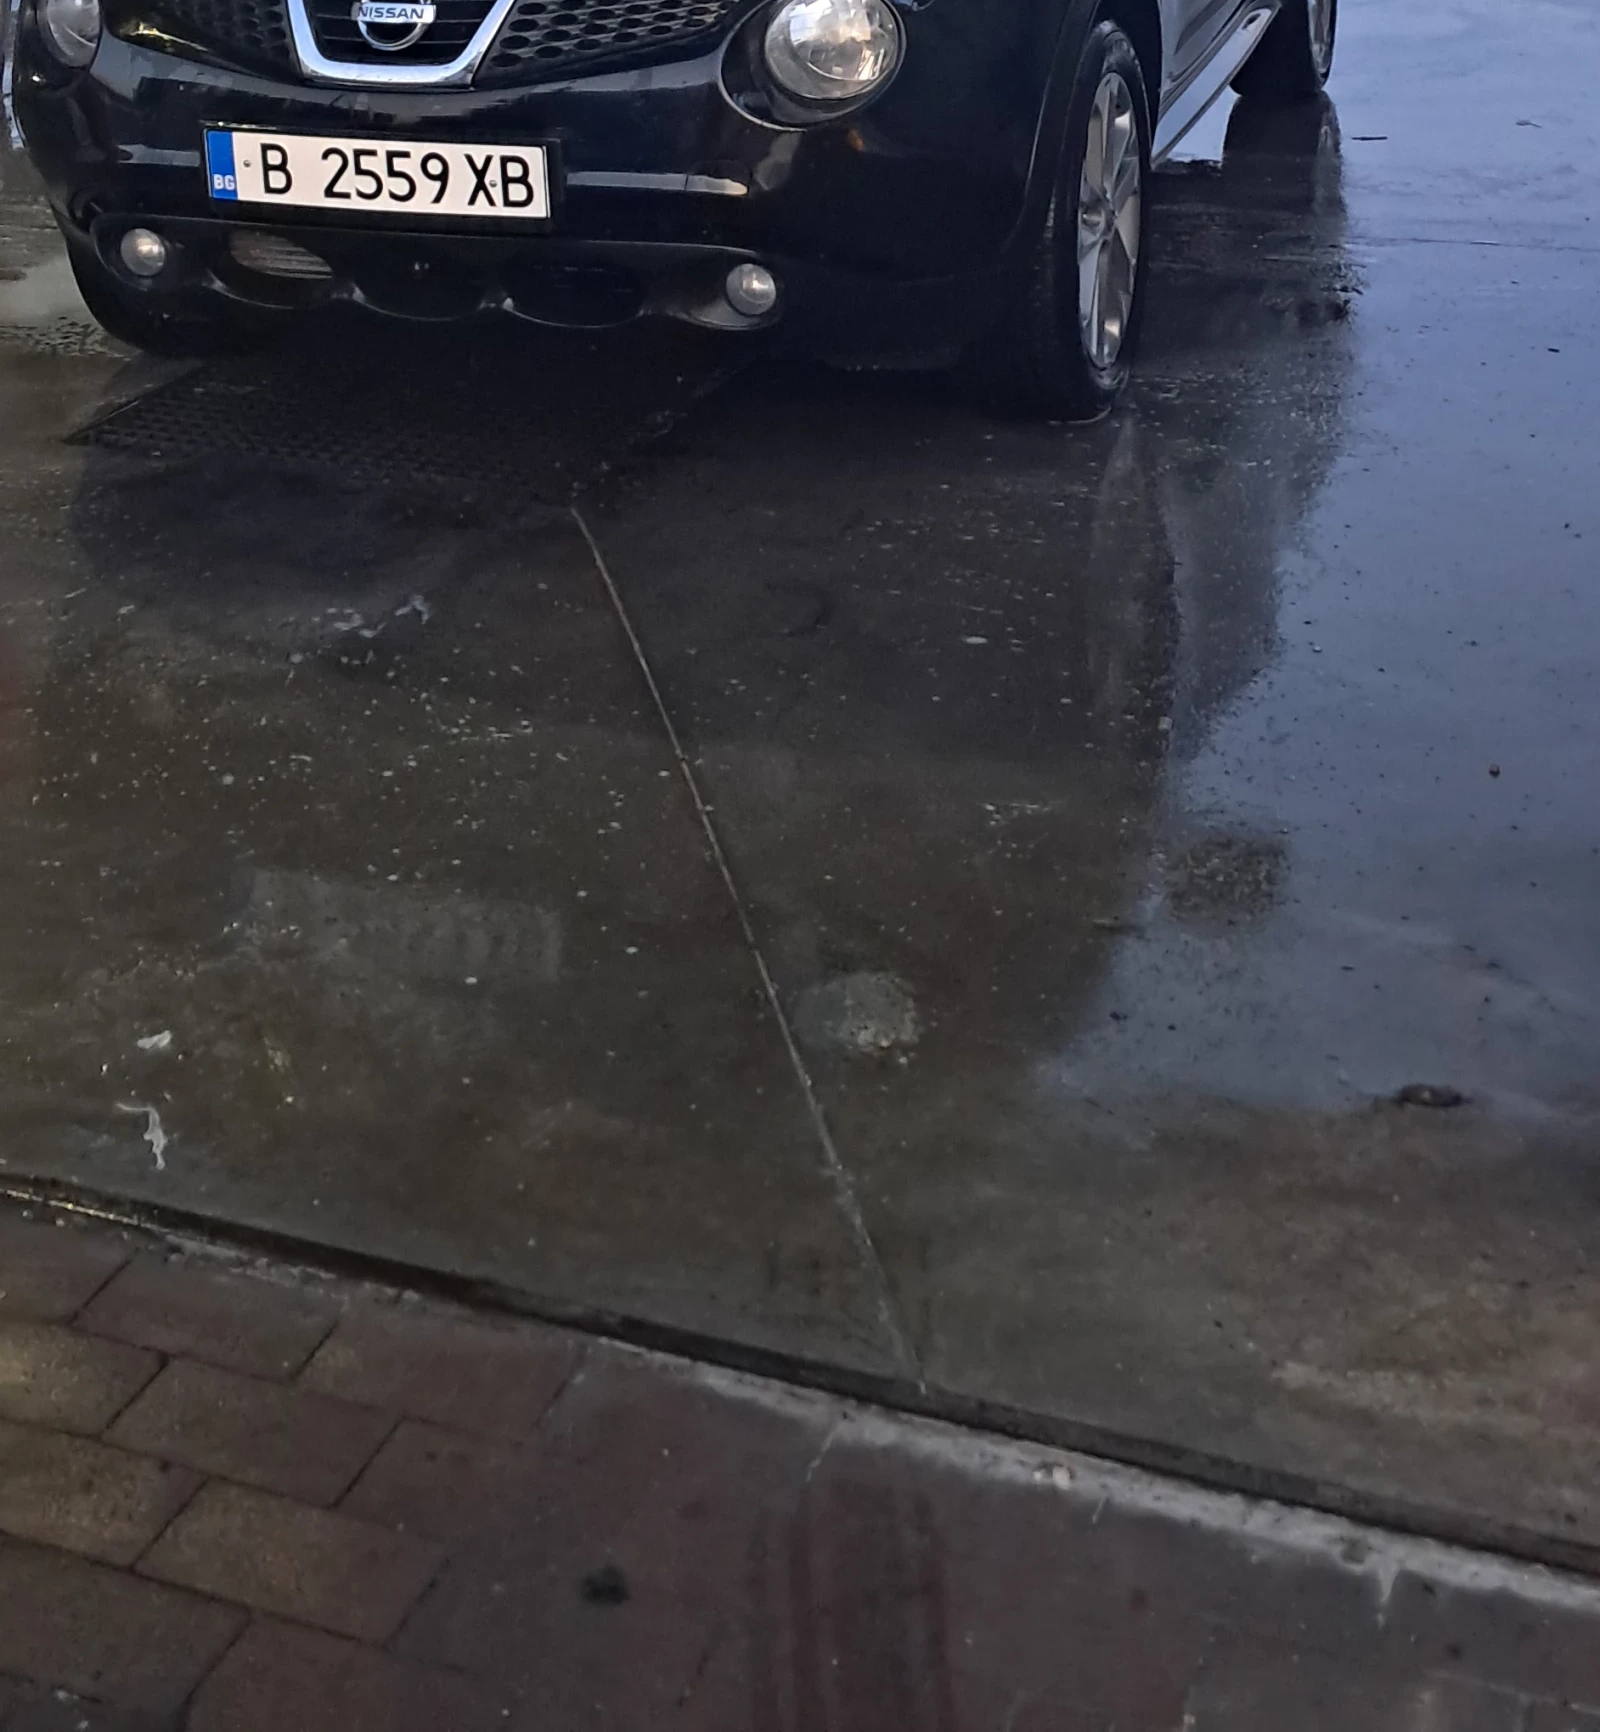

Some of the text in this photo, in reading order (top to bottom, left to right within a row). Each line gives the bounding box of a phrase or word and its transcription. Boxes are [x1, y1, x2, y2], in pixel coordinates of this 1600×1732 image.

[357, 6, 424, 20] NISSAN
[213, 174, 236, 192] BG
[259, 142, 535, 208] B 2559 XB
